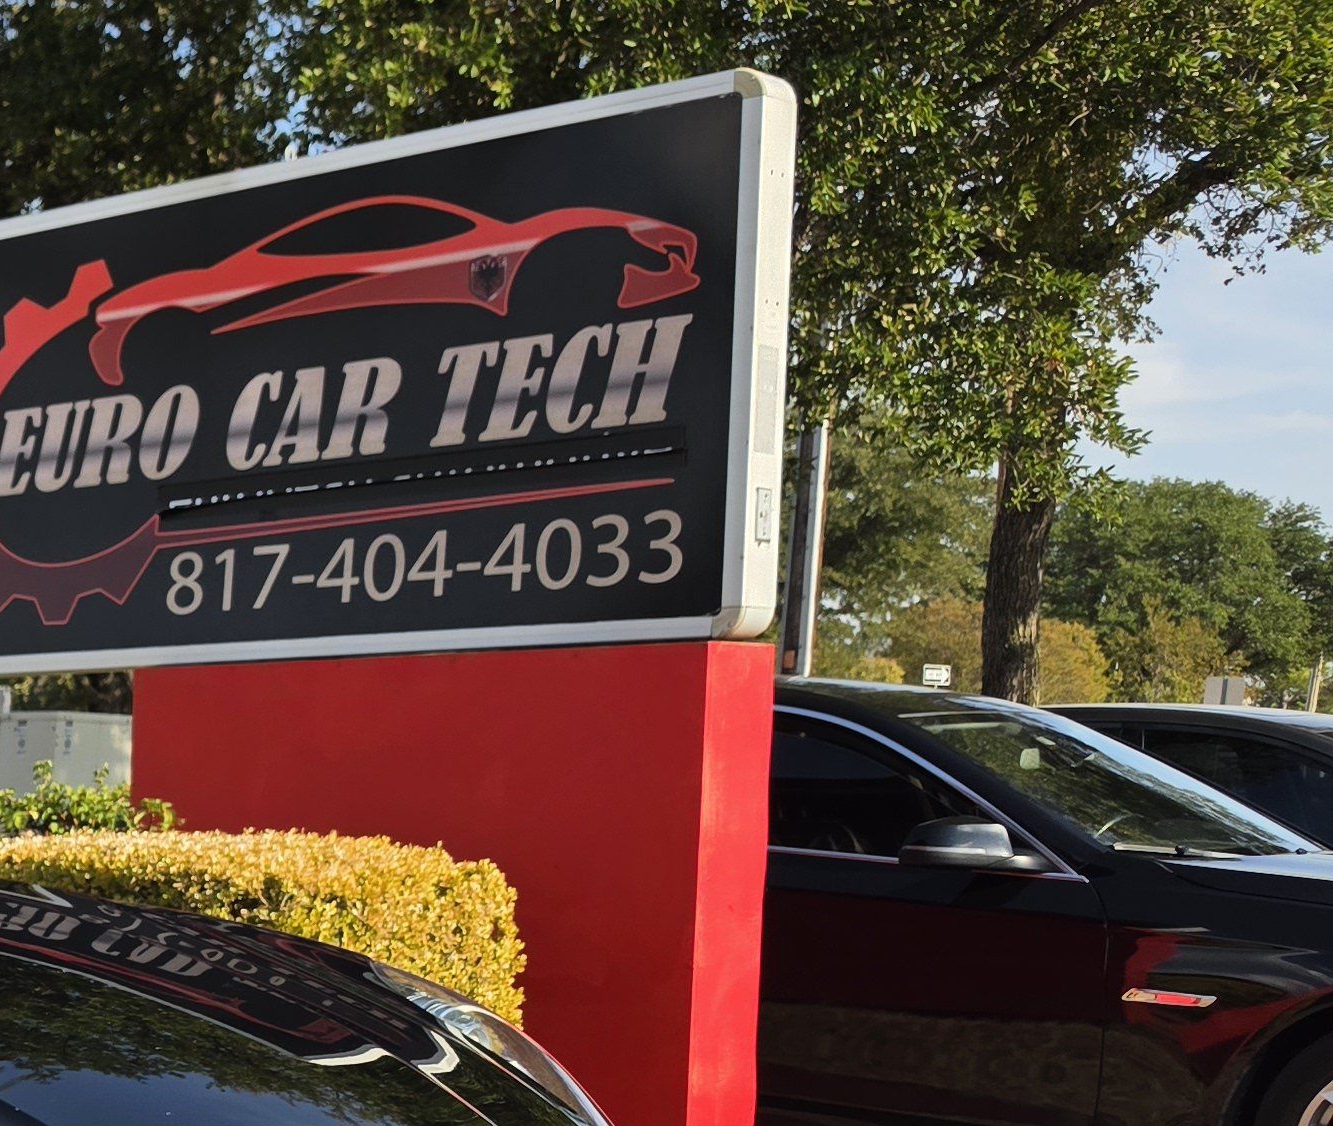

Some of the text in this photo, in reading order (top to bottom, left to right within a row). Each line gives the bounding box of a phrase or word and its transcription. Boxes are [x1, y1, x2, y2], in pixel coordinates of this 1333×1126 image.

[225, 356, 403, 471] CAR
[428, 312, 694, 448] TECH
[165, 509, 684, 616] 817-404-4033
